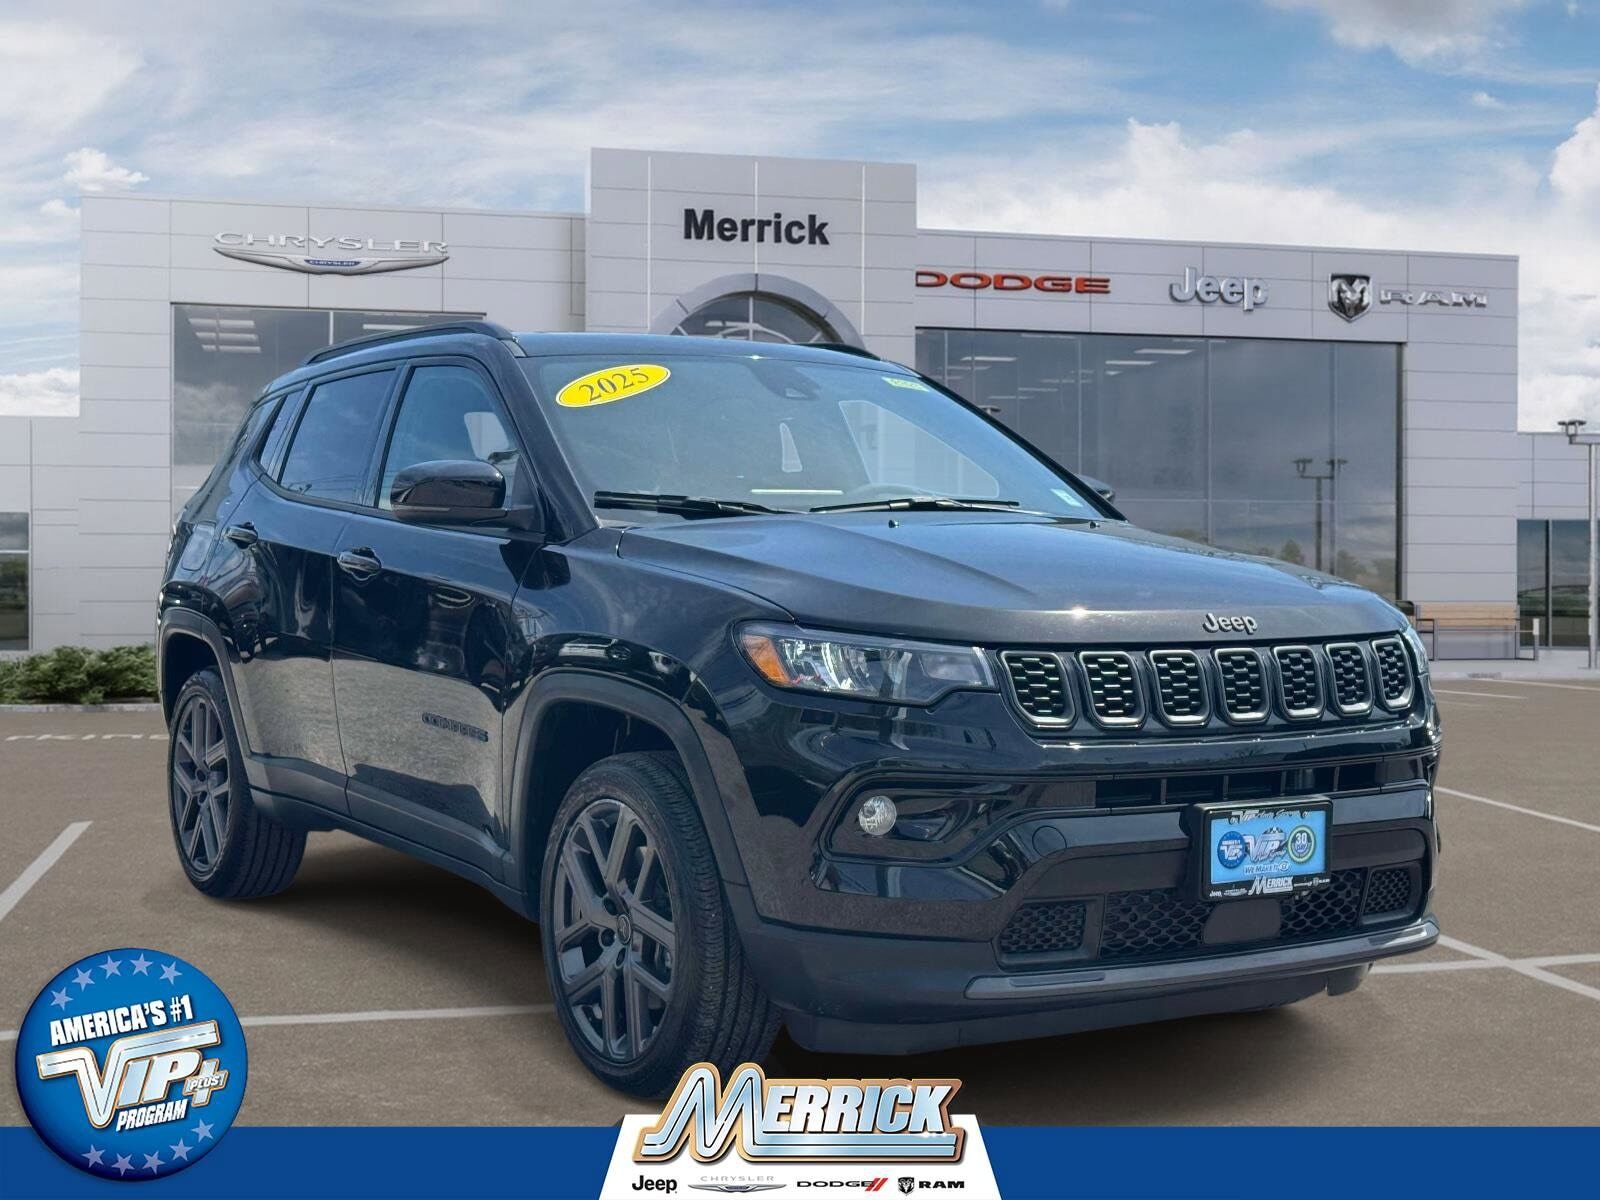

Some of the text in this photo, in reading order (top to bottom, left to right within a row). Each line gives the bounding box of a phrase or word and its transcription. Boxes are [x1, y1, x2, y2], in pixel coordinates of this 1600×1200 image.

[683, 208, 830, 246] Merrick
[214, 231, 450, 255] CHRYSLER
[915, 271, 1111, 294] DODGE
[1169, 264, 1268, 311] Jeep
[1380, 289, 1488, 308] RAM
[578, 367, 650, 402] 2025
[1203, 612, 1258, 636] Jeep
[1295, 832, 1308, 844] 30
